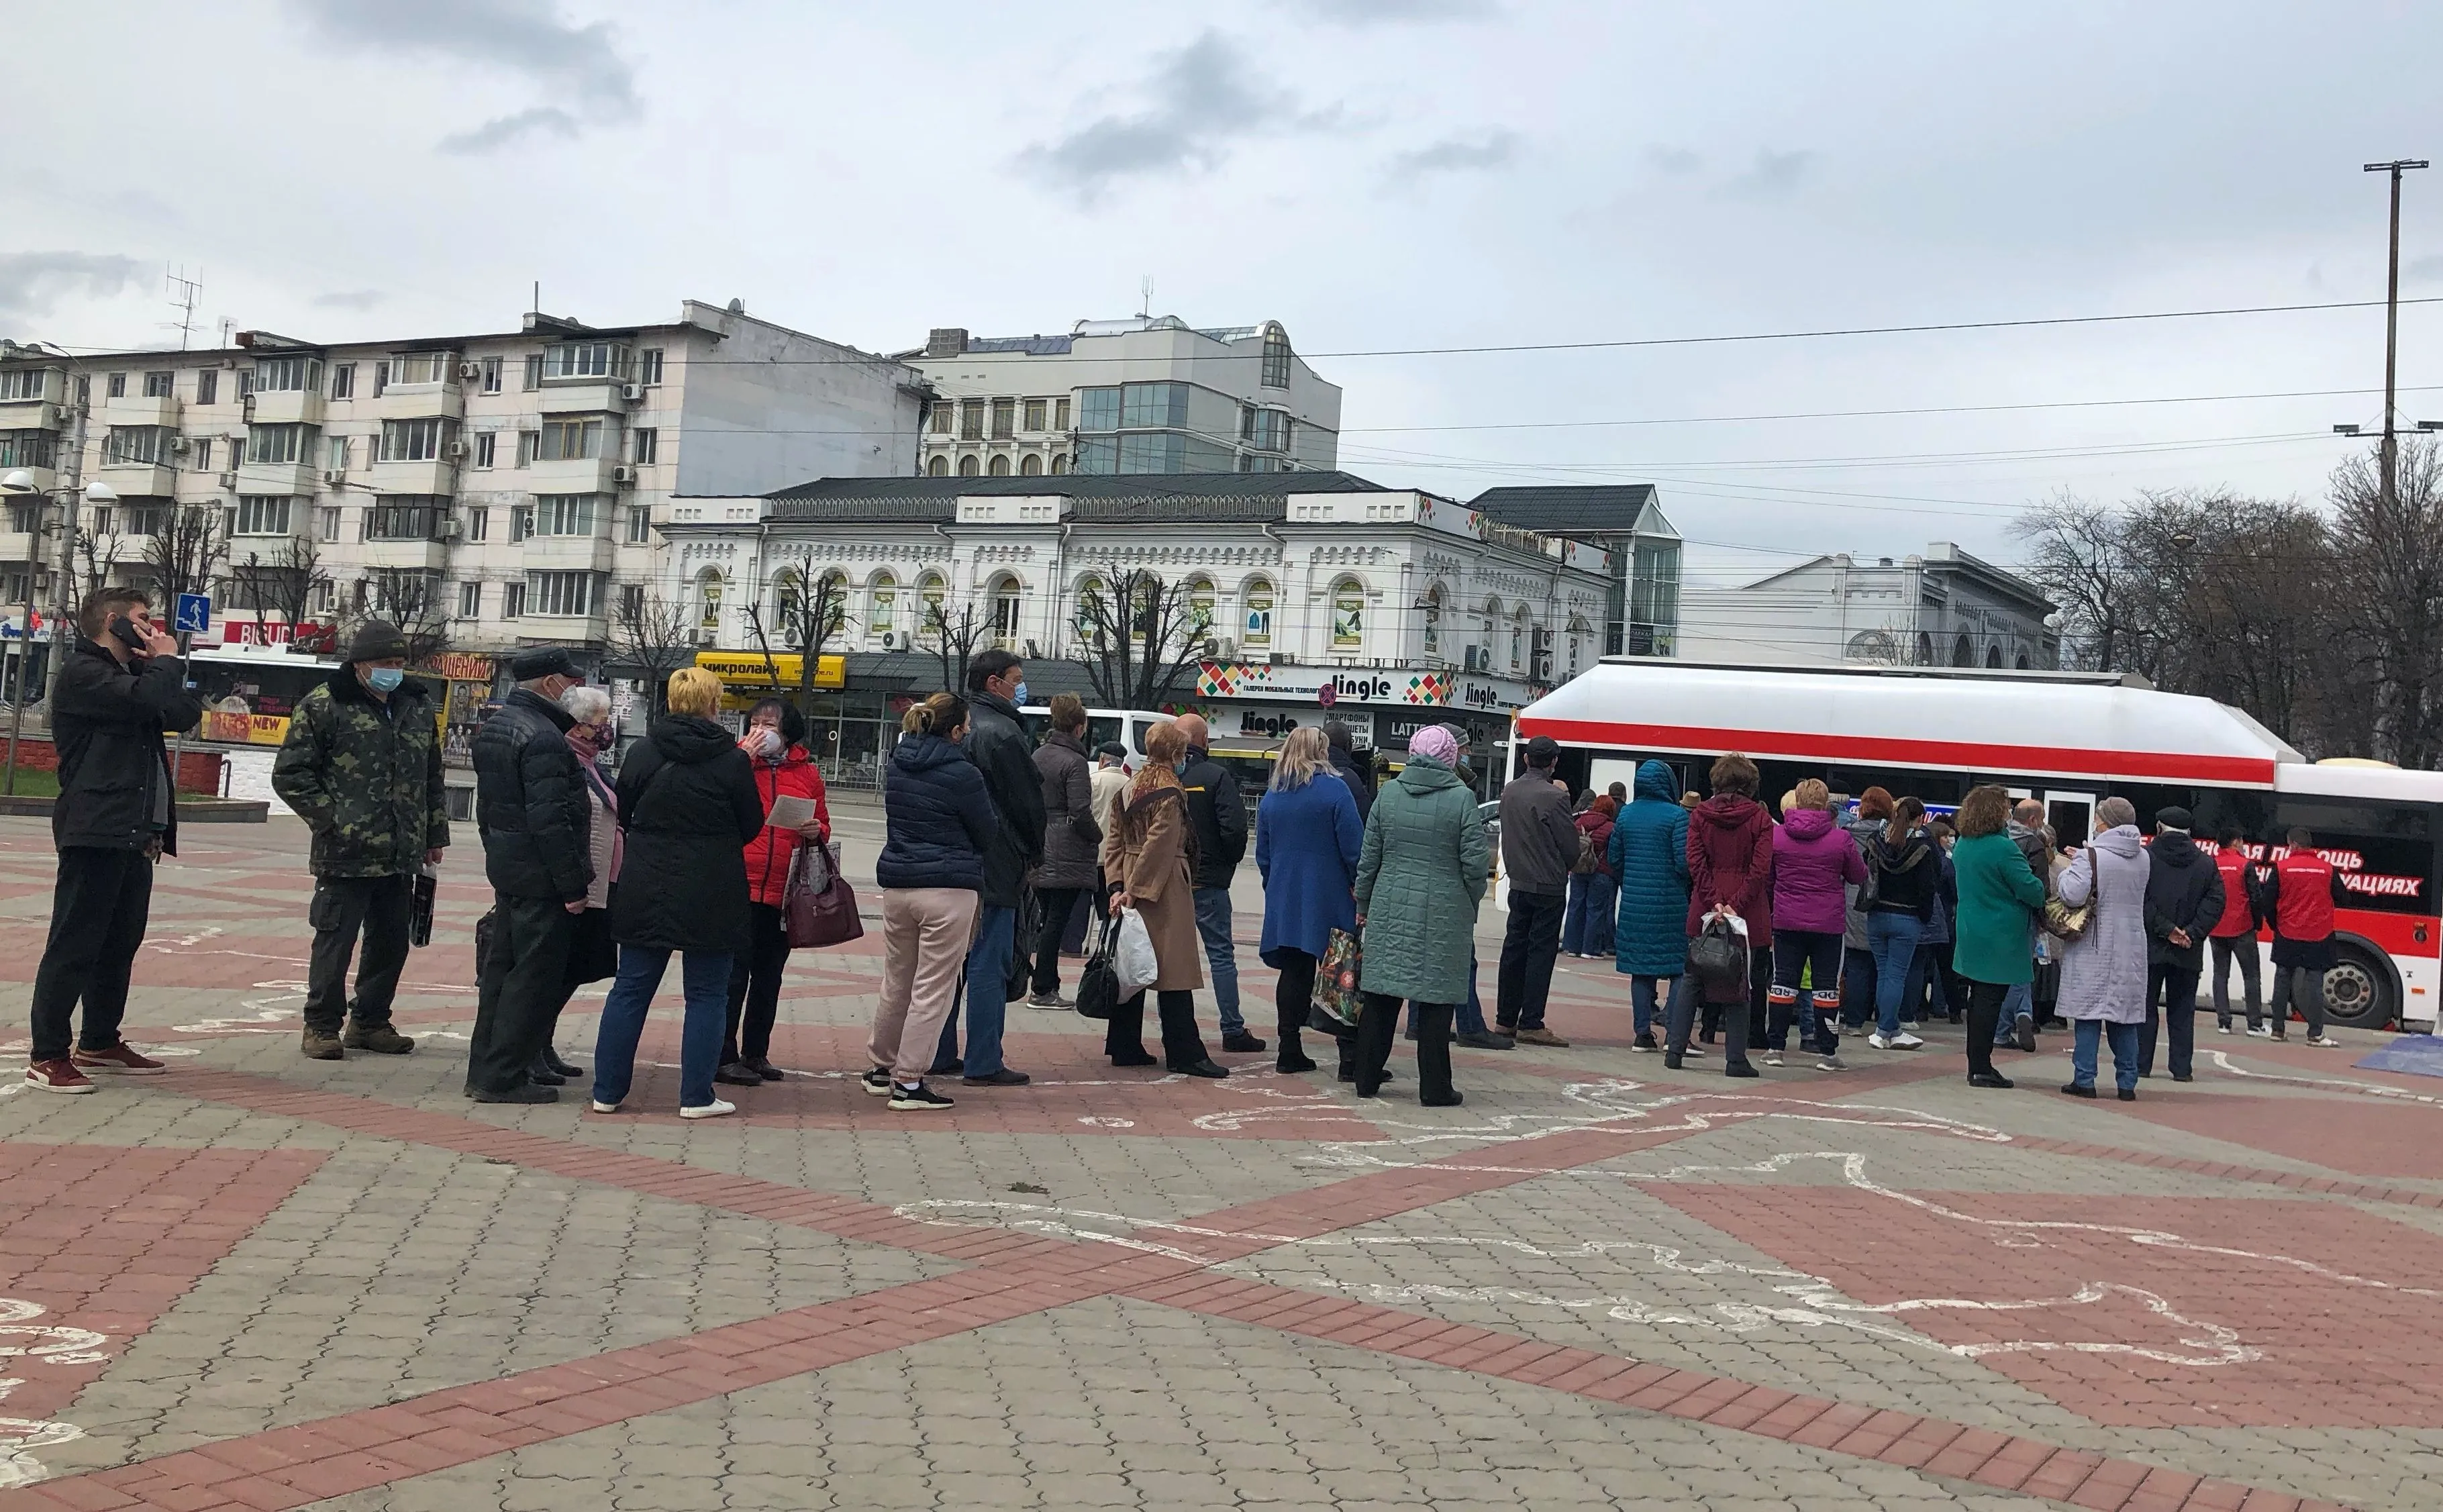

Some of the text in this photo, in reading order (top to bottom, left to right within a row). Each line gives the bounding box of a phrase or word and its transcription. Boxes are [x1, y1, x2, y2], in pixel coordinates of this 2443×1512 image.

[1332, 672, 1391, 701] Jingle
[1465, 683, 1497, 709] Jingle
[252, 717, 281, 731] NEW
[1241, 711, 1299, 738] Jingle
